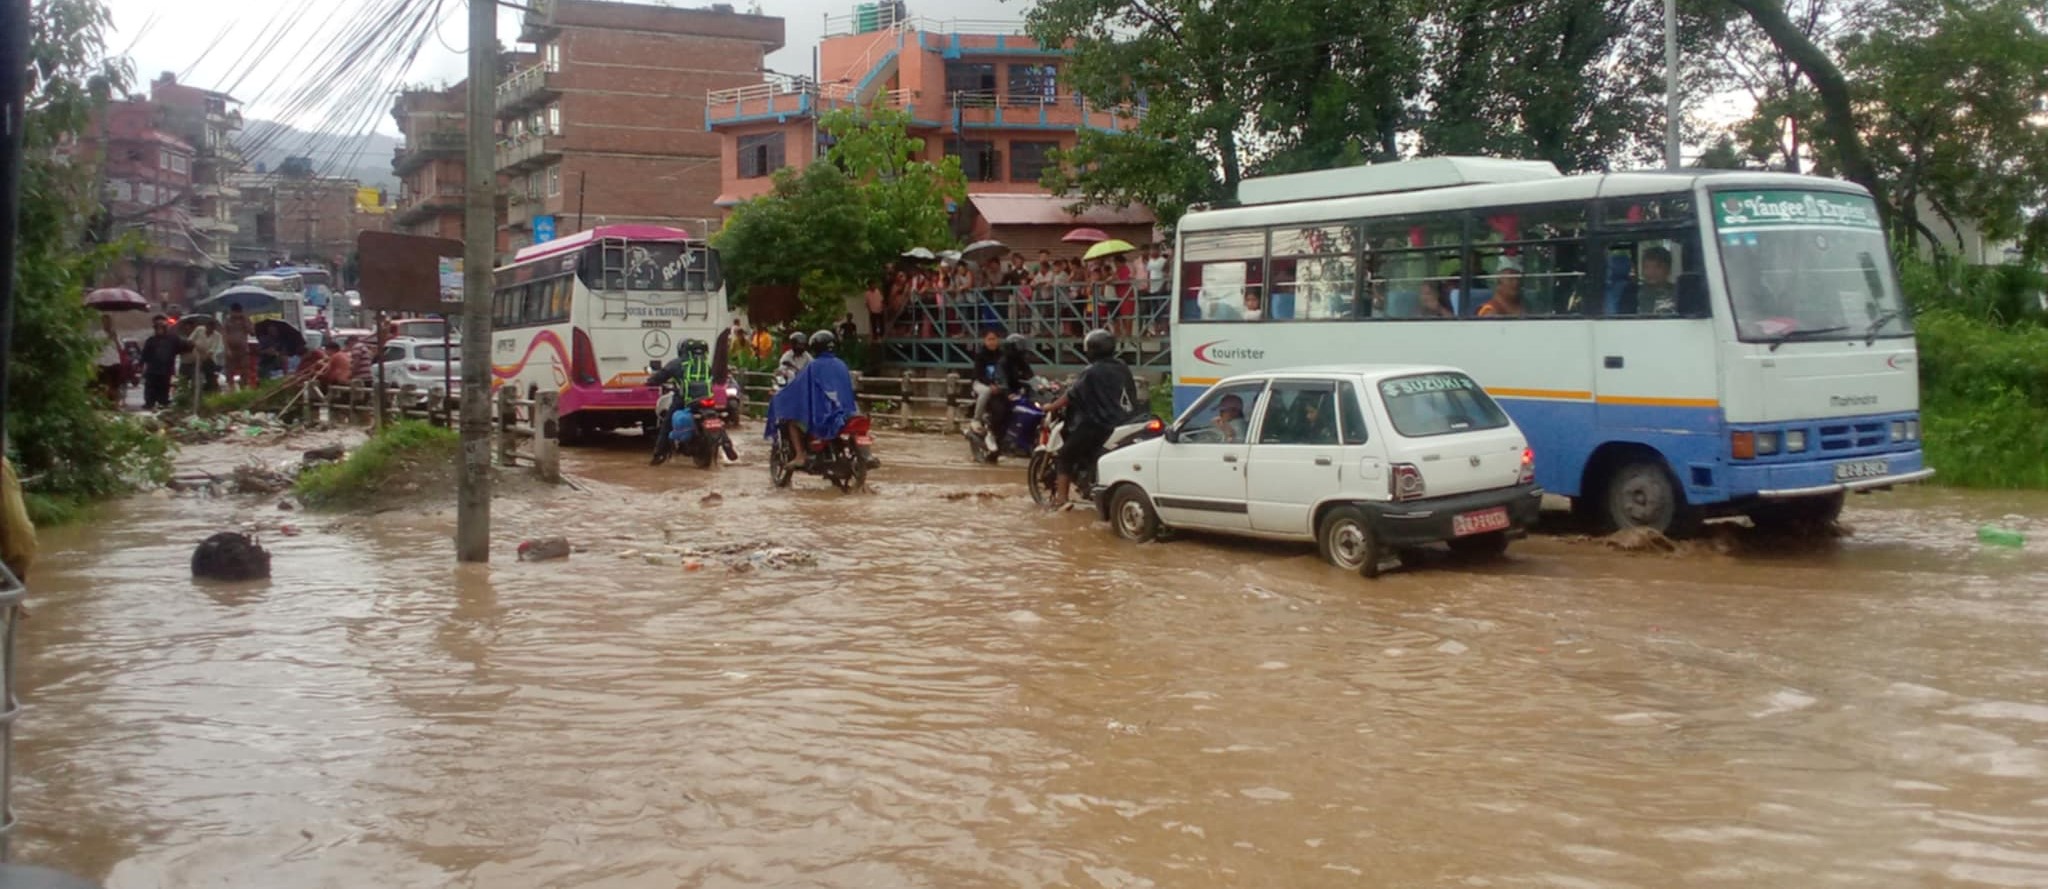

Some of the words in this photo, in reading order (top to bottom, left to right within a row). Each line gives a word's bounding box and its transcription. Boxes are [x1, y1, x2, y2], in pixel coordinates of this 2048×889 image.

[1744, 195, 1805, 220] Yangee
[1212, 347, 1265, 359] tourister
[1401, 378, 1462, 394] SUZUKI
